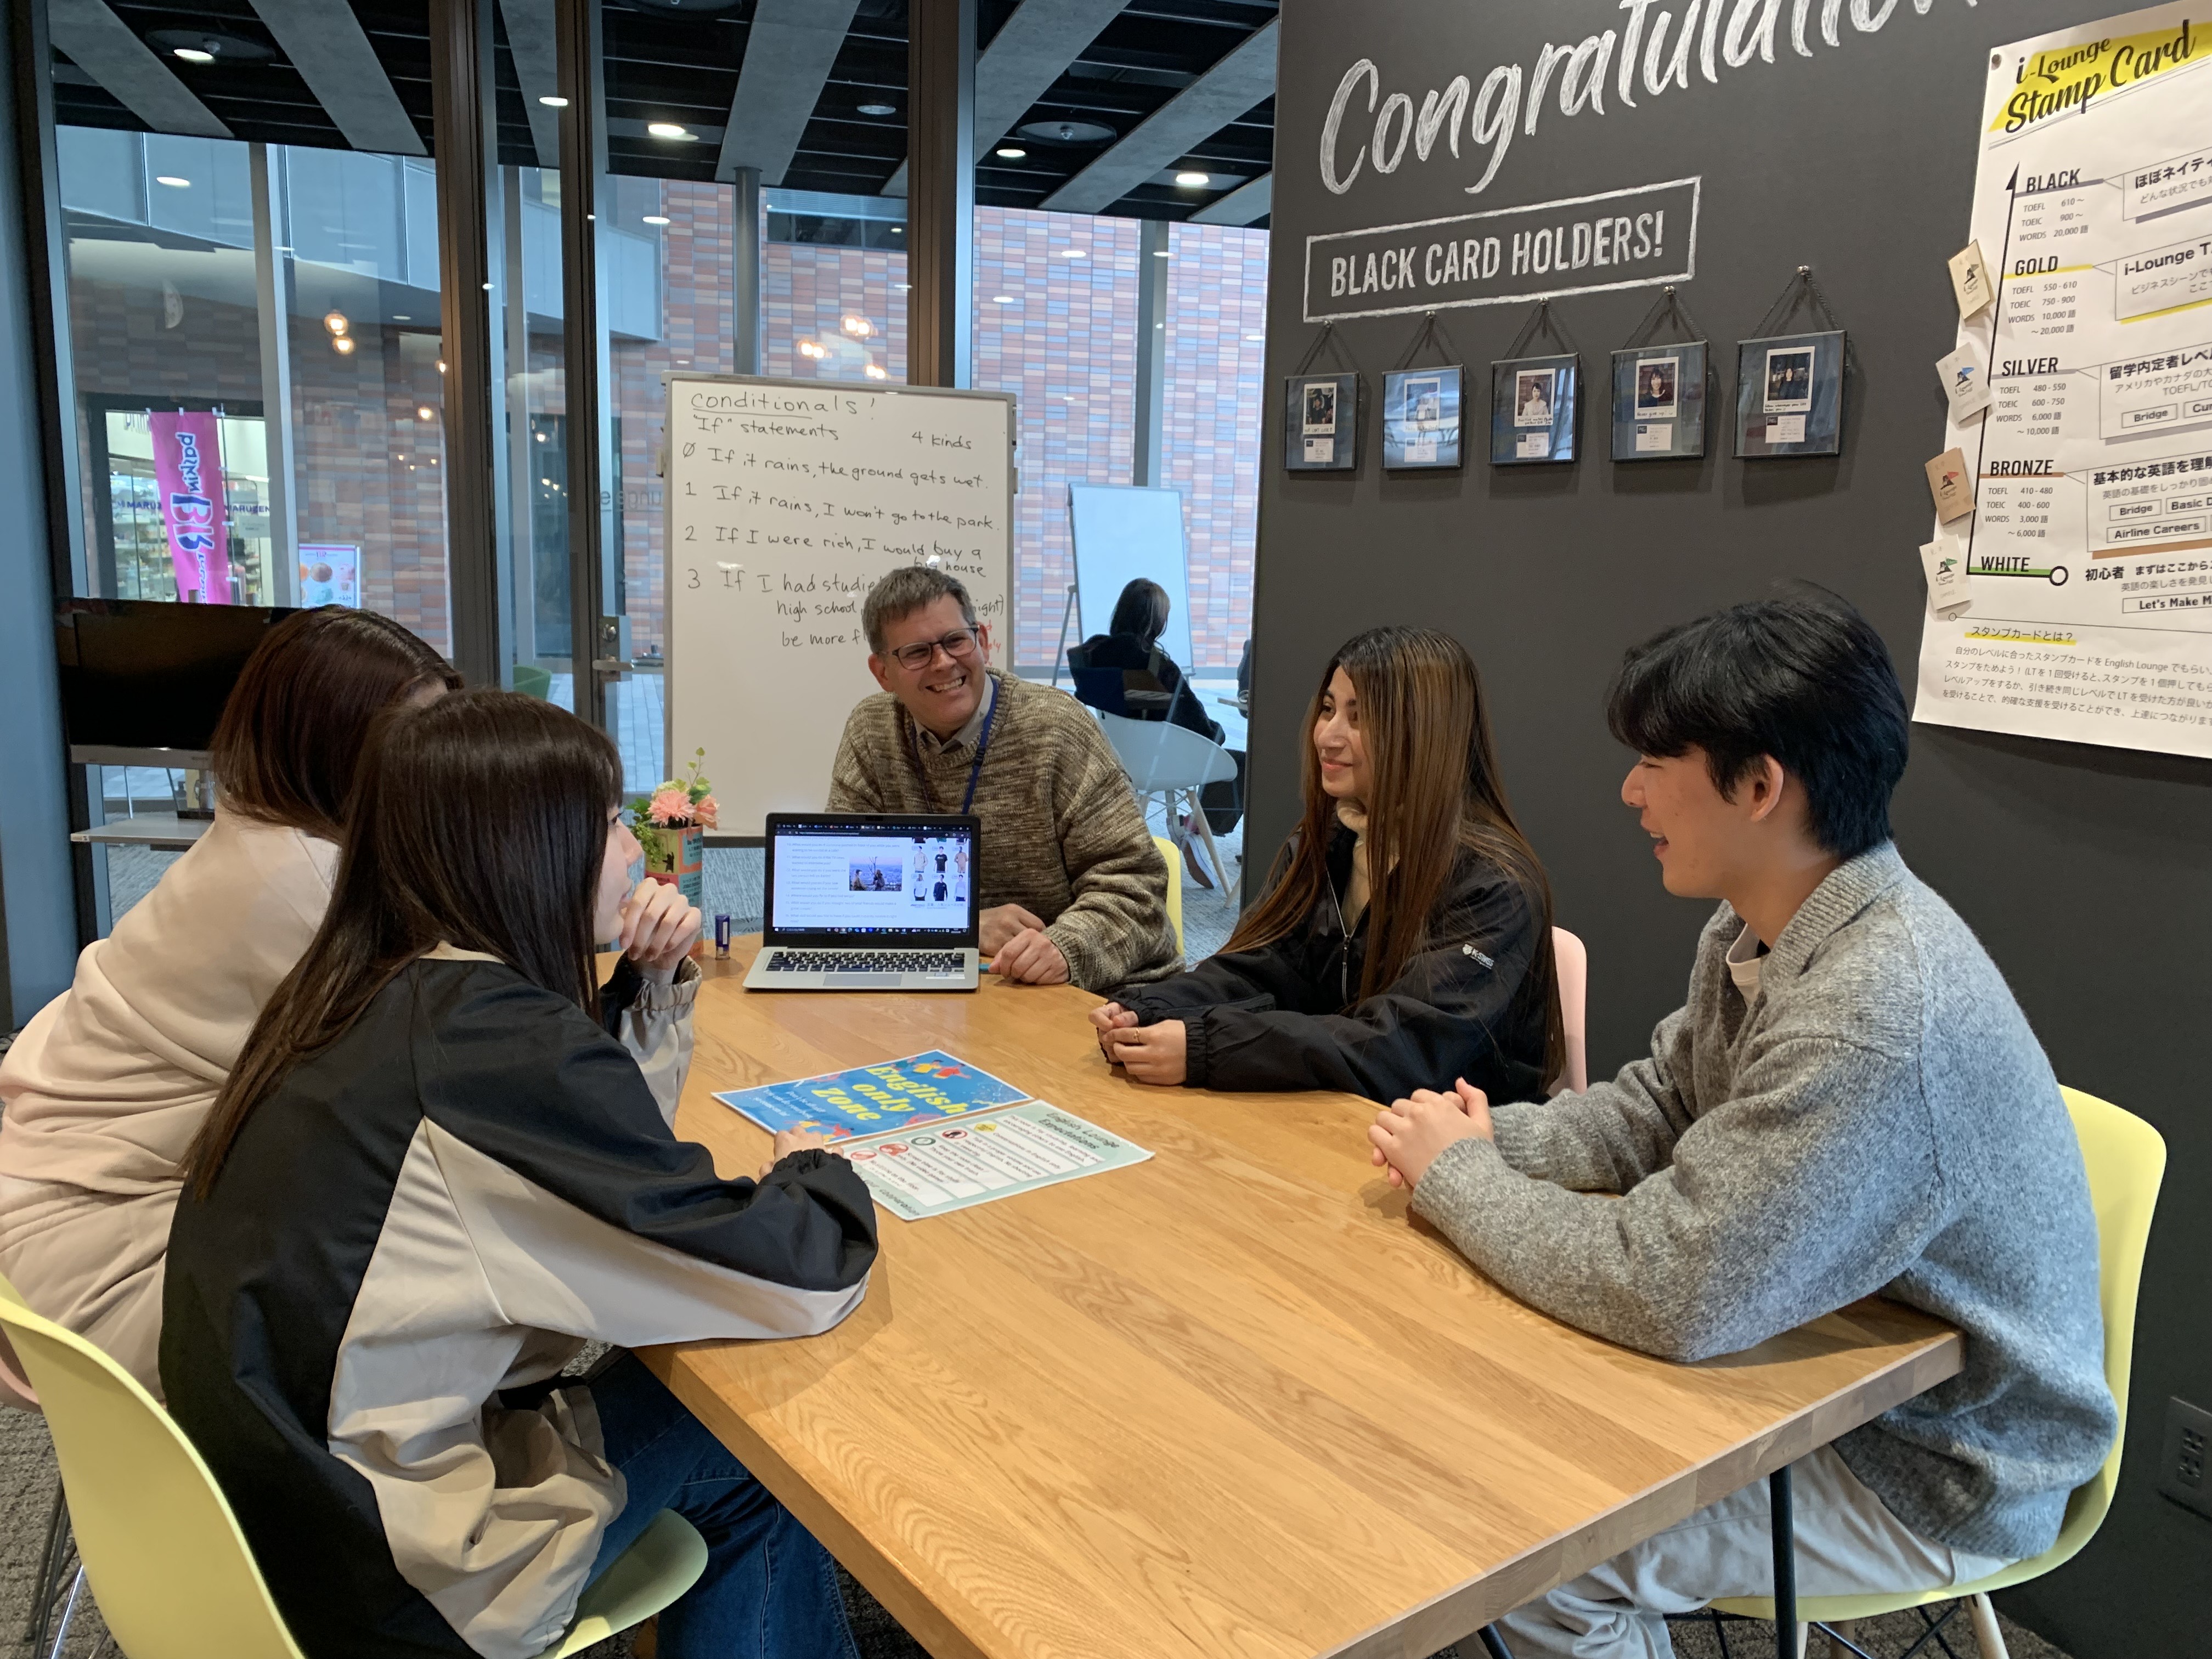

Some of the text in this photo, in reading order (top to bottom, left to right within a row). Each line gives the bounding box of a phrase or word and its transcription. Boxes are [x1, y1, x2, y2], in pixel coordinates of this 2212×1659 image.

[2005, 19, 2196, 133] Stamp Card
[2027, 168, 2081, 193] BLACK
[2024, 203, 2045, 212] TOEFL
[2022, 217, 2043, 227] TOEIC
[2019, 232, 2046, 241] WORDS
[1331, 210, 1663, 297] BLACK CARD HOLDERS!
[2015, 256, 2058, 276] GOLD
[2124, 250, 2194, 275] i-Lounge
[2013, 286, 2034, 295] TOEFL
[2011, 301, 2030, 309] TOEIC
[2008, 314, 2035, 323] WORDS
[2002, 357, 2058, 376] SILVER
[1996, 414, 2022, 422] WORDS
[2134, 410, 2168, 422] Bridge
[741, 420, 838, 440] statements
[912, 431, 972, 450] 4 kinds
[708, 448, 734, 464] If
[744, 454, 756, 467] it
[765, 458, 816, 478] rains,
[819, 461, 848, 476] the
[852, 468, 903, 481] ground
[910, 470, 946, 486] gets
[1990, 460, 2054, 476] BRONZE
[686, 482, 697, 495] 1
[713, 486, 742, 500] If
[749, 491, 761, 505] it
[770, 495, 819, 518] rains,
[823, 502, 834, 516] I
[844, 506, 884, 518] won't
[892, 512, 907, 525] go
[912, 510, 925, 521] to
[929, 511, 952, 523] the
[2120, 505, 2153, 516] Bridge
[2171, 499, 2202, 510] Basic
[2114, 523, 2200, 539] Airline Careers
[685, 526, 697, 541] 2
[715, 526, 738, 544] If
[747, 530, 759, 544] I
[768, 535, 813, 547] were
[862, 538, 876, 550] I
[884, 544, 924, 556] would
[934, 540, 962, 561] buy
[972, 548, 981, 560] a
[946, 561, 986, 577] house
[1981, 556, 2030, 572] WHITE
[688, 568, 700, 589] 3
[720, 570, 746, 592] If
[757, 574, 773, 592] I
[783, 573, 815, 592] had
[2085, 566, 2124, 581] 初心者
[777, 600, 807, 622] high
[2140, 599, 2165, 610] Let's
[2170, 596, 2198, 608] Make
[783, 631, 803, 647] be
[810, 634, 846, 645] more
[2104, 659, 2134, 670] English
[2136, 662, 2169, 672] Lounge
[852, 1084, 916, 1111] only
[866, 1066, 969, 1114] English
[1046, 1113, 1119, 1148] English Lounge
